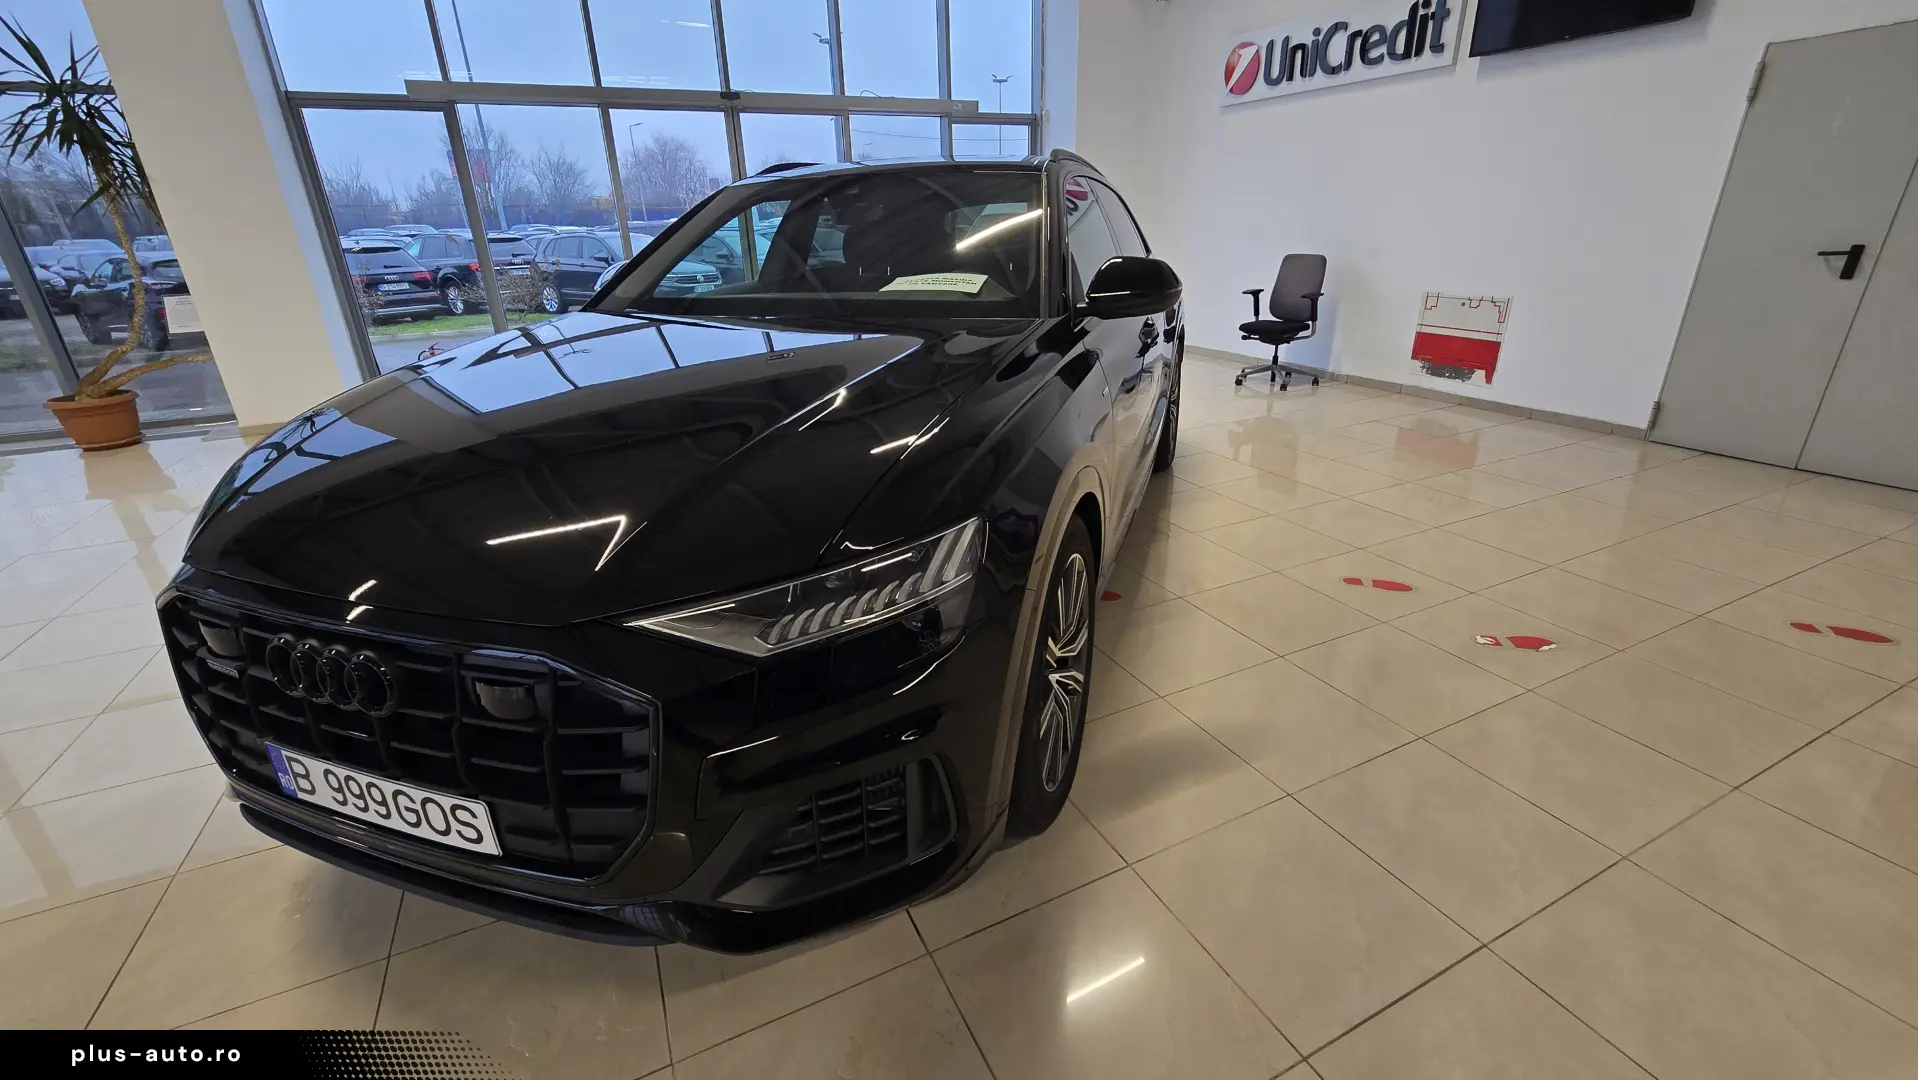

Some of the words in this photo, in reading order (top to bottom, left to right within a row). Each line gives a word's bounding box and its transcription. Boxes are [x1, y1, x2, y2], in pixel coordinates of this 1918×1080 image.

[1263, 0, 1450, 87] UniCredit
[278, 772, 295, 790] RO
[287, 754, 316, 796] B
